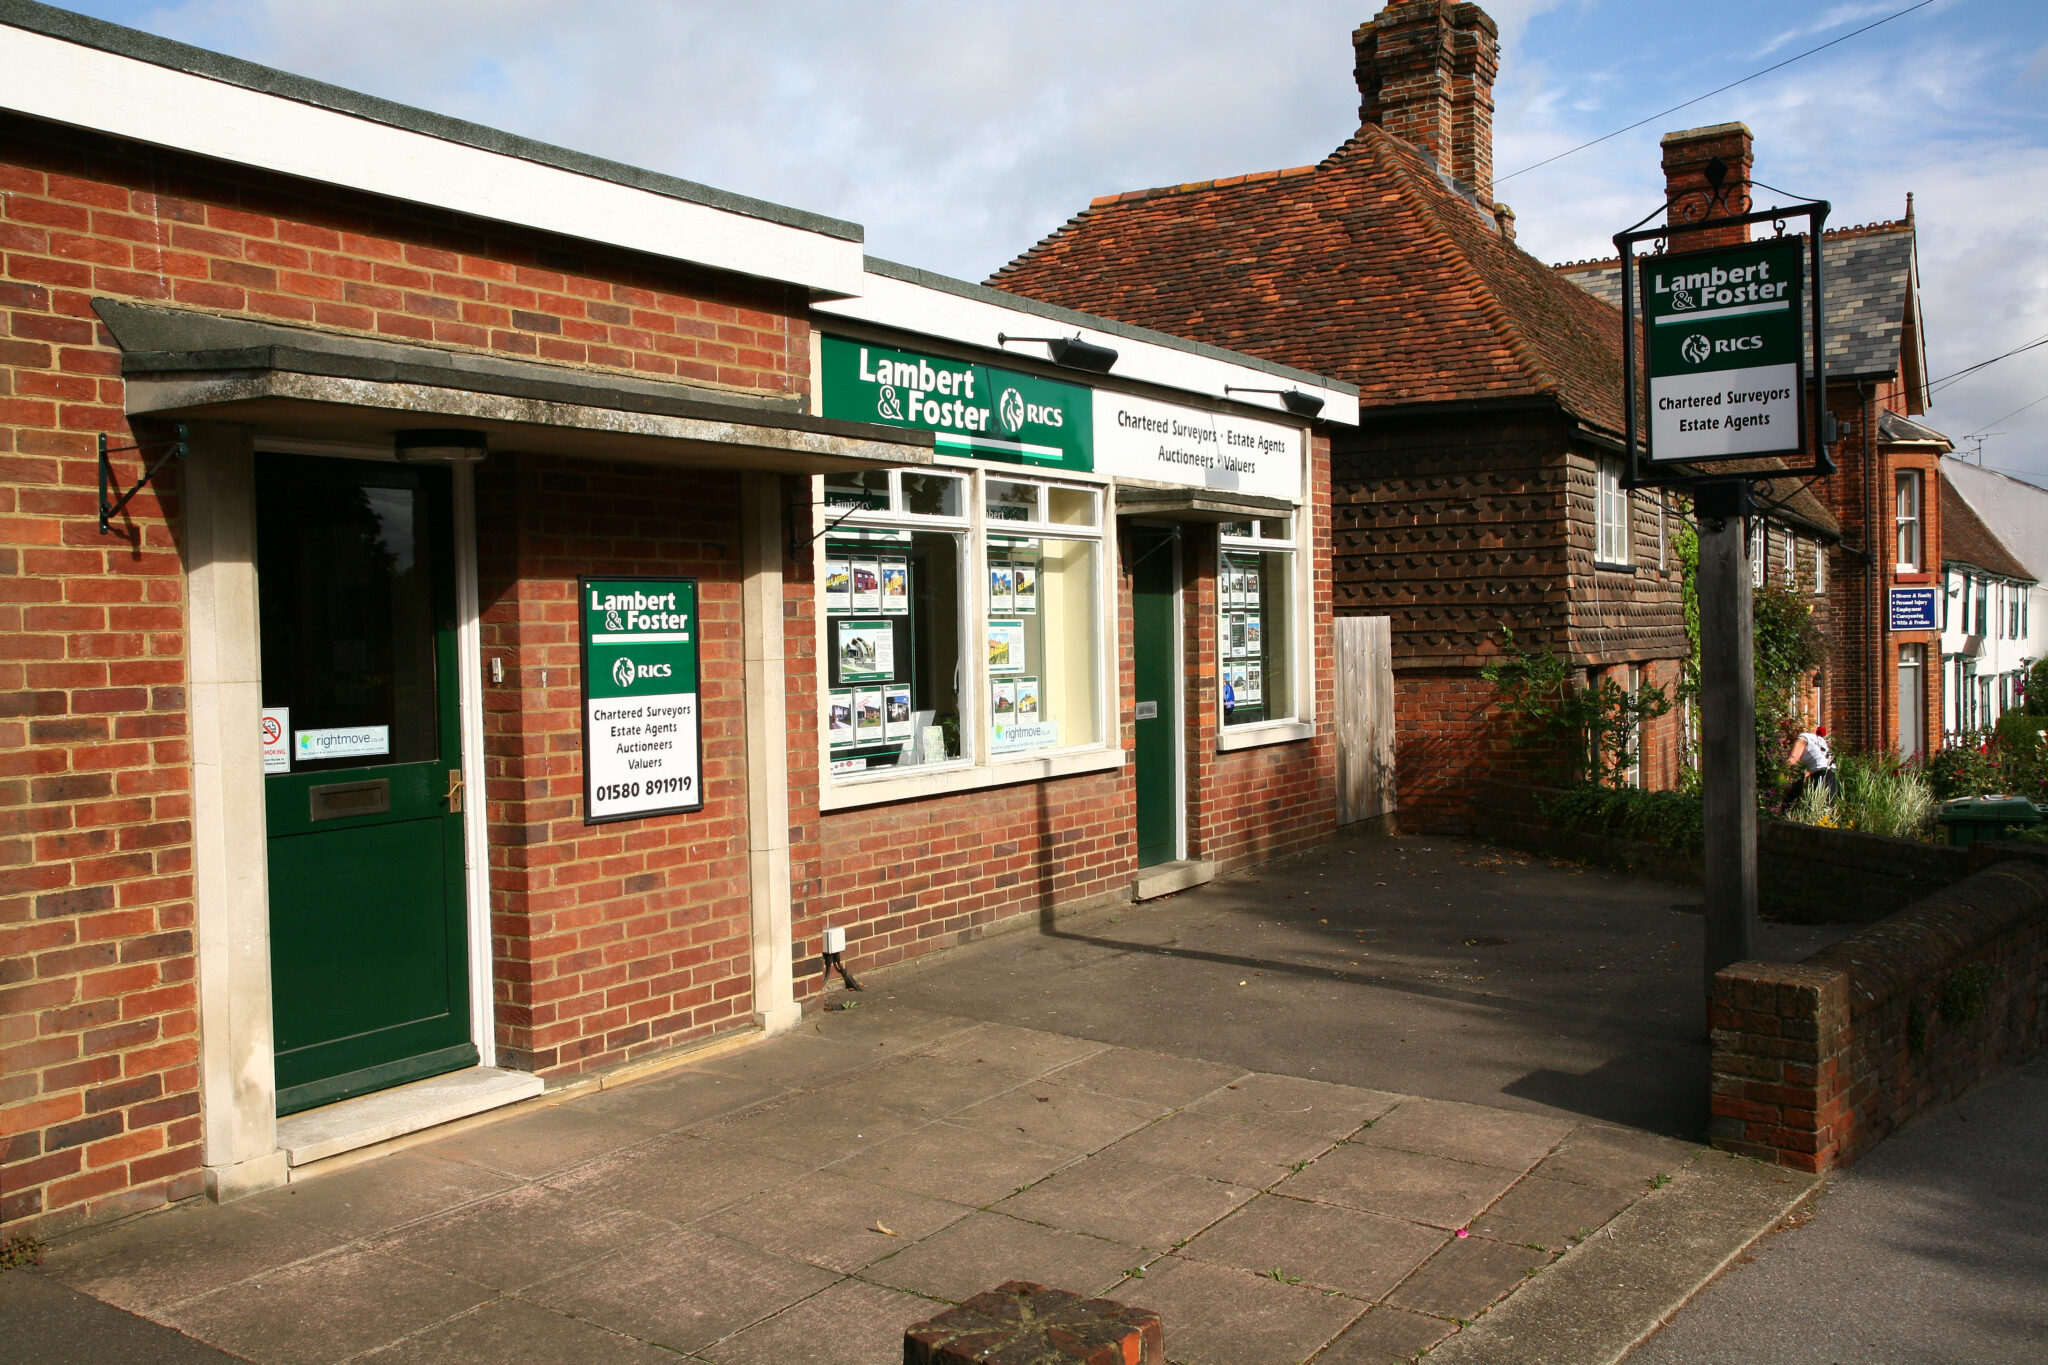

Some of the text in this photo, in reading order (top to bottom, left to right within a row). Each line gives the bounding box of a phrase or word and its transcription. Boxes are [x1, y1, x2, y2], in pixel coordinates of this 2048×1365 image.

[1655, 261, 1770, 294] Lambert
[1672, 281, 1788, 310] & Foster
[1715, 335, 1763, 353] RICS
[859, 348, 974, 399] Lambert
[878, 385, 990, 431] & Foster
[1659, 388, 1790, 410] Chartered Surveyors
[1027, 404, 1063, 427] RICS
[1680, 413, 1770, 432] Estate Agents
[1117, 410, 1285, 455] Chartered Surveyors Estate Agents
[1158, 446, 1256, 474] Auctioneers Valuers
[592, 591, 675, 610] Lambert
[605, 610, 688, 631] & Foster
[637, 664, 672, 678] RICS
[594, 706, 691, 721] Chartered Surveyors
[611, 723, 677, 737] Estate Agents
[616, 741, 673, 754] Auctioneers
[628, 758, 662, 770] Valuers
[597, 776, 691, 801] 01580 891919
